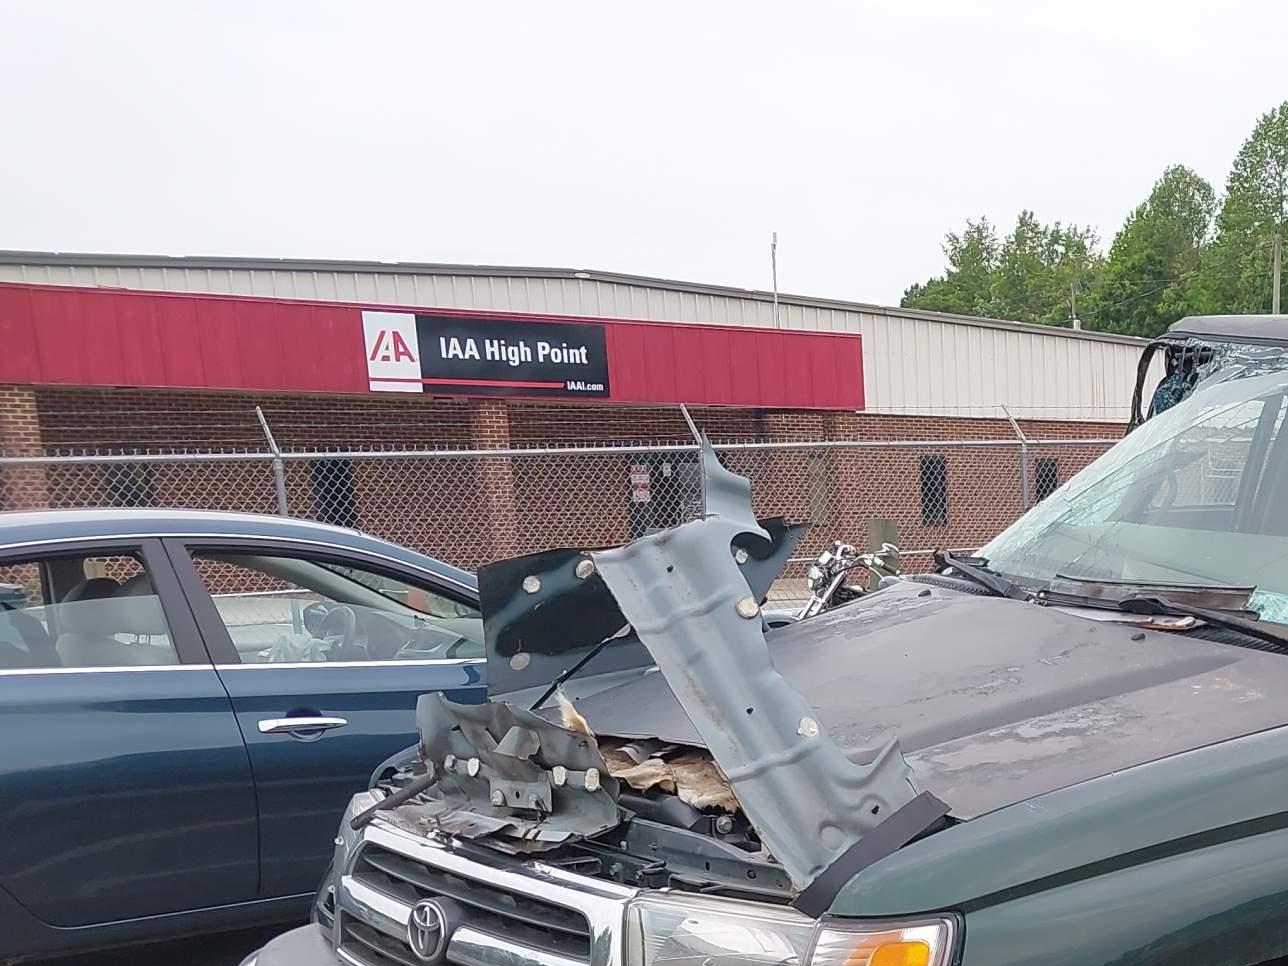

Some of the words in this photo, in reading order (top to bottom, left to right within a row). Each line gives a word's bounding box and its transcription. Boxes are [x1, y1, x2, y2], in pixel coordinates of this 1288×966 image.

[439, 336, 481, 361] IAA
[484, 338, 532, 367] High
[537, 341, 589, 365] Point
[566, 380, 604, 392] IAAI.com
